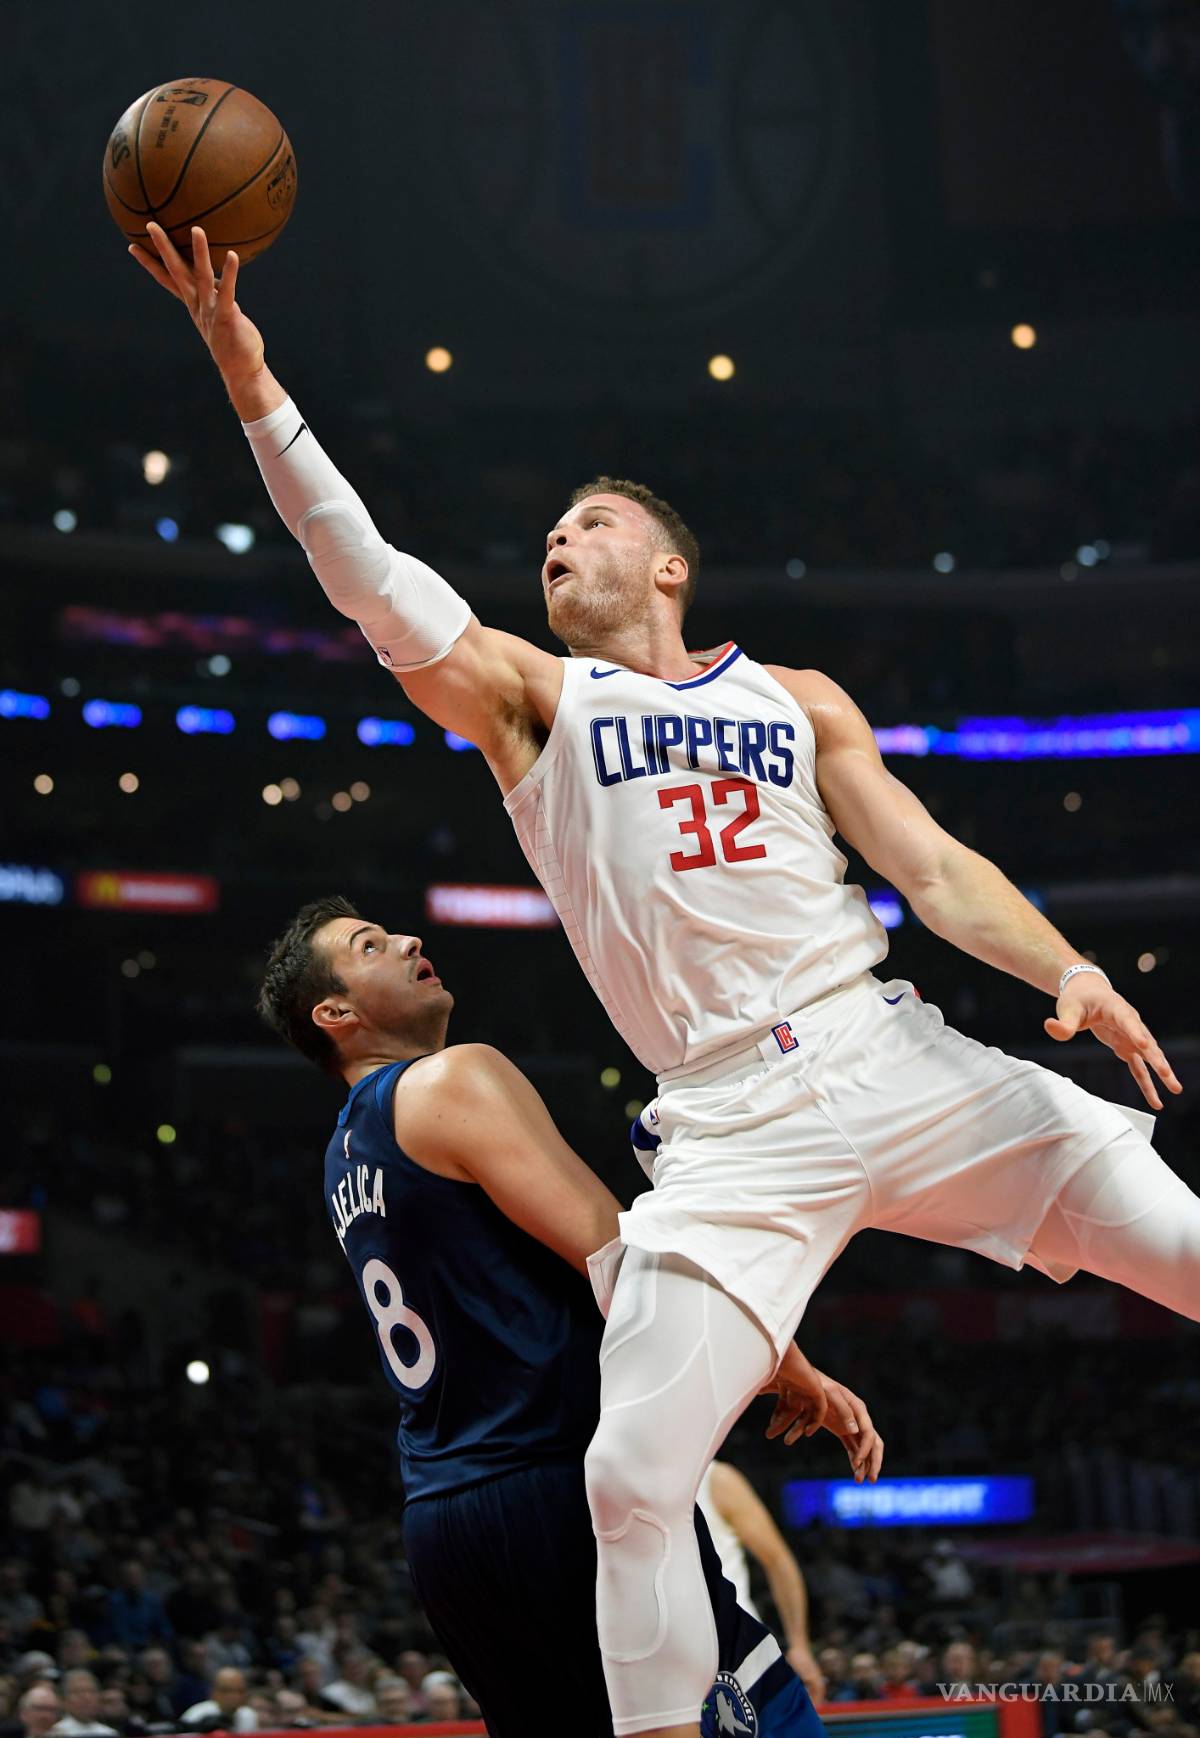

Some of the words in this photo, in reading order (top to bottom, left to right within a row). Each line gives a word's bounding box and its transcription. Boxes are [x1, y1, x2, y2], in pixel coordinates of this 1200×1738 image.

[590, 714, 795, 788] CLIPPERS
[657, 778, 767, 872] 32
[332, 1164, 386, 1256] JELICA
[362, 1258, 436, 1390] 8
